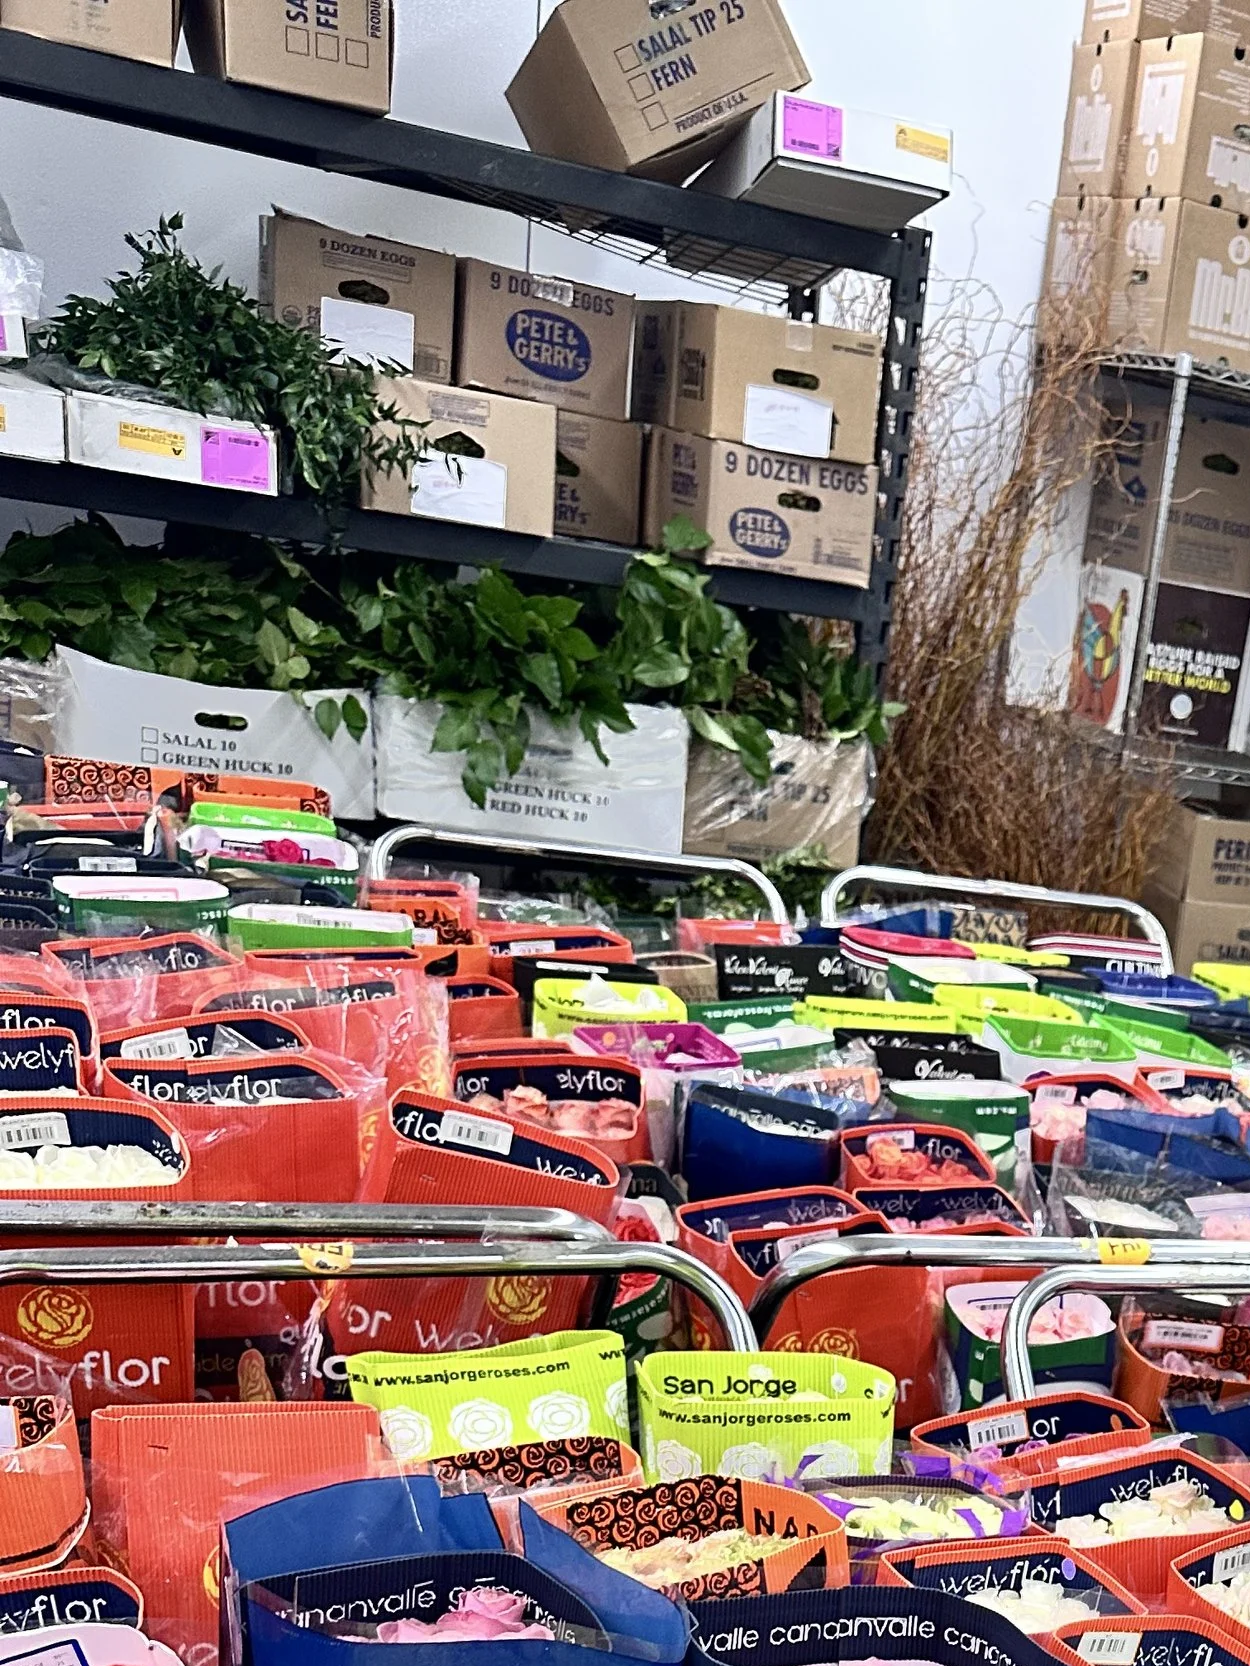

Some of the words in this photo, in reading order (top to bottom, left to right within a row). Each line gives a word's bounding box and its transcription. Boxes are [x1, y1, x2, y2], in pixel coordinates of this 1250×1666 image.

[637, 20, 692, 62] SALAL
[689, 5, 717, 37] TIP
[719, 0, 746, 25] 25
[651, 53, 698, 92] FERN
[674, 105, 713, 133] PRODUCT
[319, 237, 327, 250] 9
[330, 239, 378, 262] DOZEN
[380, 251, 417, 268] EGGS
[490, 271, 501, 290] 9
[572, 292, 615, 316] EGGS
[516, 313, 565, 343] PETE
[725, 451, 738, 473] 9
[746, 454, 811, 485] DOZEN
[818, 466, 869, 495] EGGS
[736, 512, 770, 533] PETE
[162, 732, 217, 750] SALAL
[220, 740, 237, 752] 10
[162, 752, 221, 770] GREEN
[224, 759, 273, 775] HUCK
[277, 763, 294, 776] 10
[492, 782, 546, 799] GREEN
[547, 786, 592, 805] HUCK
[490, 798, 526, 815] RED
[527, 802, 572, 823] HUCK
[374, 1359, 571, 1387] www.sanjorgeroses.com
[664, 1375, 715, 1395] San
[723, 1375, 798, 1399] Jorge
